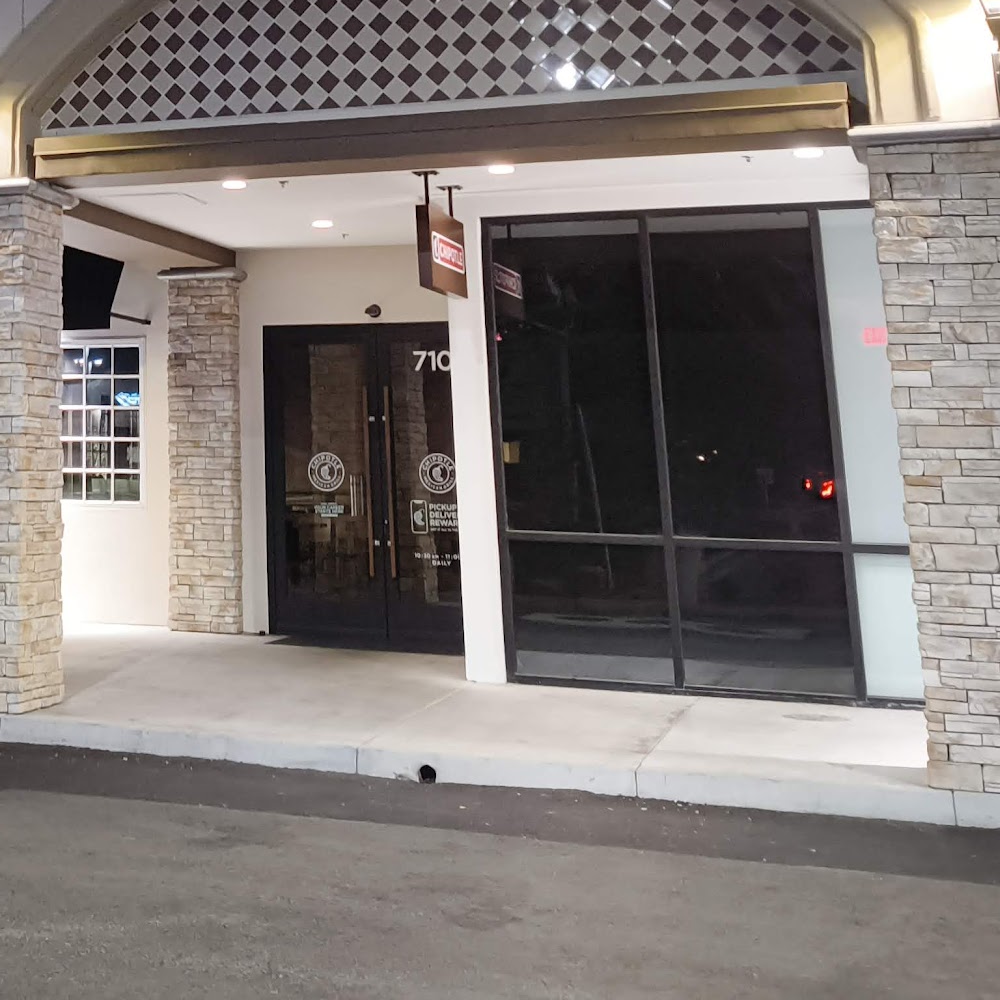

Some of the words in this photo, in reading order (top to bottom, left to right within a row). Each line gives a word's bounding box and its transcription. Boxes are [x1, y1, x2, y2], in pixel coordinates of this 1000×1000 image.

[412, 350, 450, 371] 710
[311, 455, 342, 469] CHIPOTLE
[422, 456, 455, 470] CHIPOTLE
[429, 503, 457, 511] PICKUP
[430, 511, 457, 519] DELIVE
[430, 519, 458, 527] REWAR
